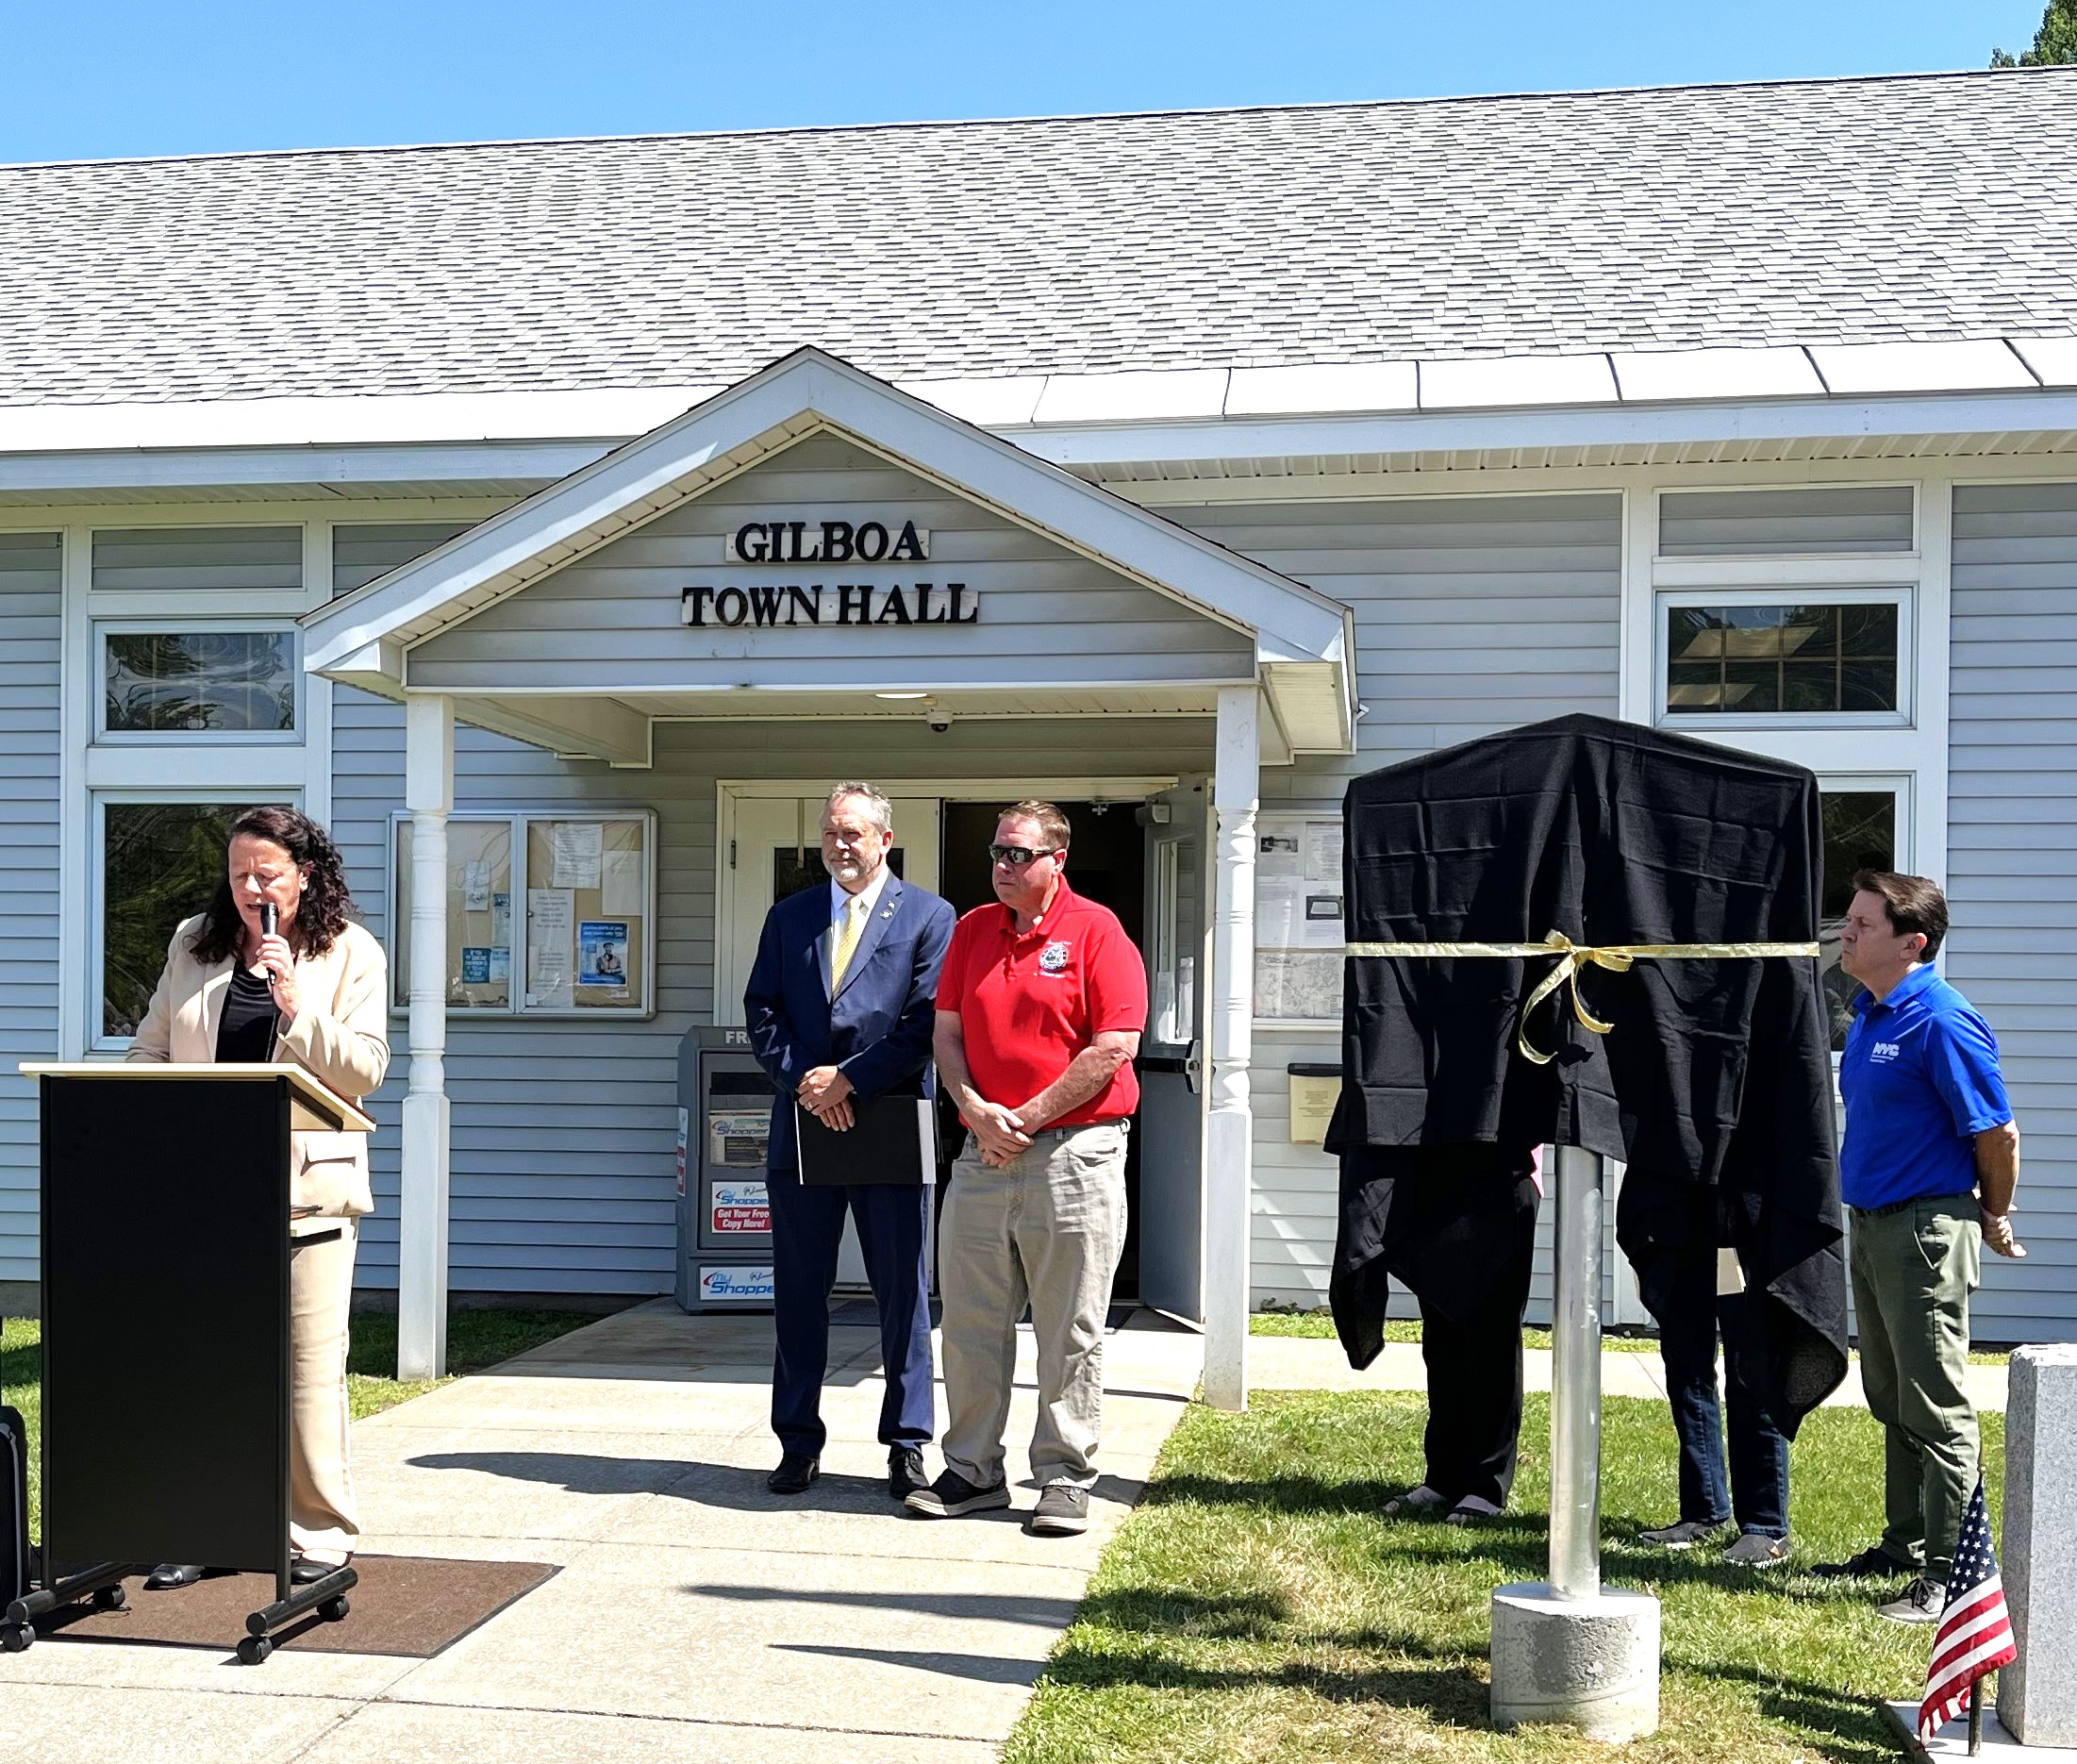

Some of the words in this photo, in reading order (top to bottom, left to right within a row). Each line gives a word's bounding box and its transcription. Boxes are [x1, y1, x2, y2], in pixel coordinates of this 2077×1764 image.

[735, 520, 927, 563] GILBOA
[682, 585, 823, 626] TOWN
[836, 583, 978, 624] HALL
[725, 1030, 752, 1044] FR
[1872, 1041, 1900, 1057] NYC
[720, 1195, 769, 1206] Shoppe
[718, 1208, 732, 1219] Get
[734, 1208, 752, 1219] Your
[752, 1208, 770, 1219] Free
[723, 1219, 742, 1230] Copy
[743, 1219, 765, 1228] Here!
[709, 1282, 773, 1295] Shoppe
